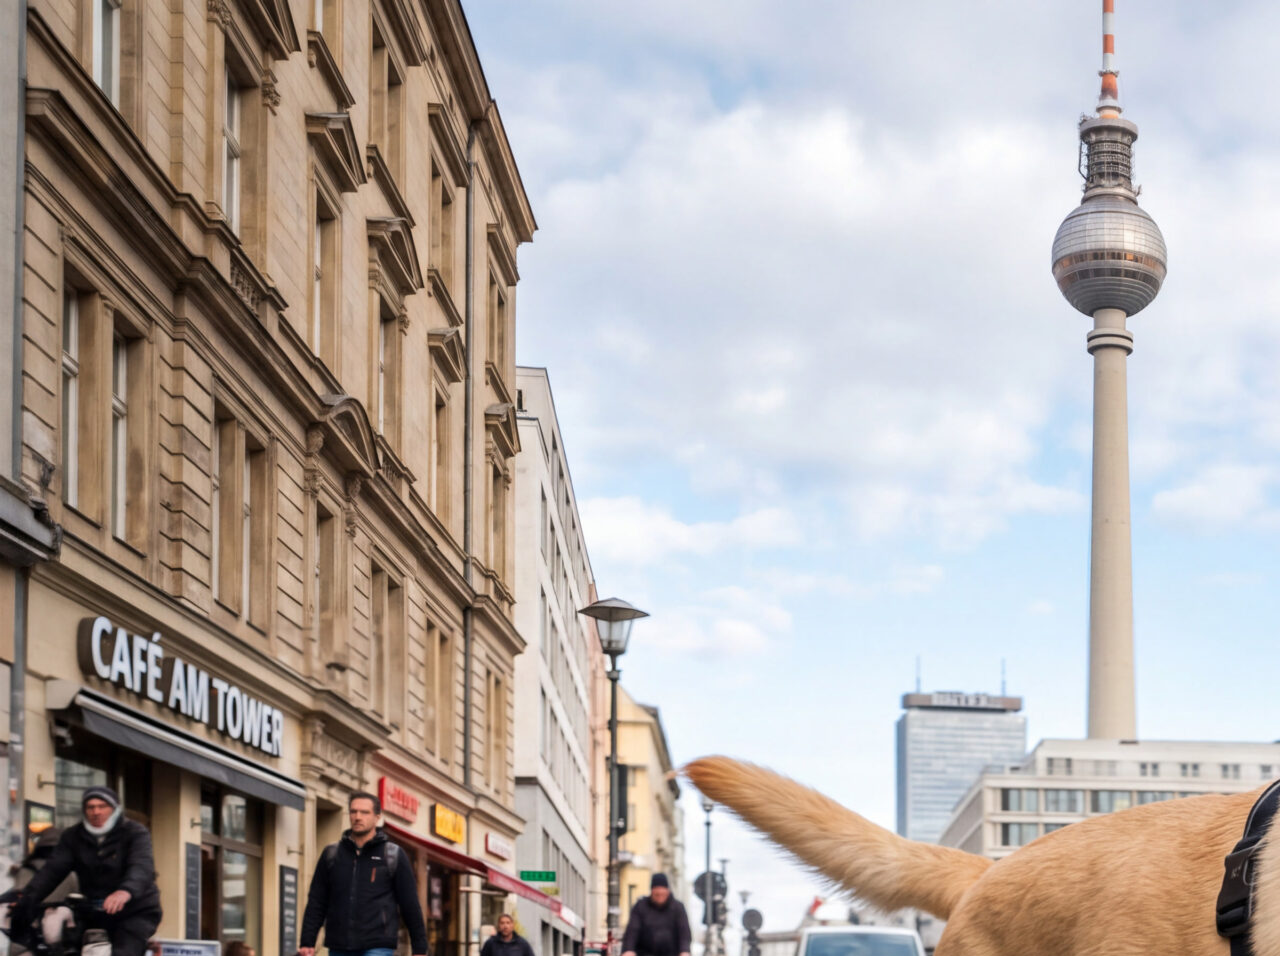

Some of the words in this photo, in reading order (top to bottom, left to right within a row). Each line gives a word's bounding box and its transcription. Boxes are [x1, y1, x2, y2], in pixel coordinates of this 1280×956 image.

[91, 616, 164, 703] CAFÉ
[168, 657, 210, 725] AM
[212, 677, 284, 758] TOWER
